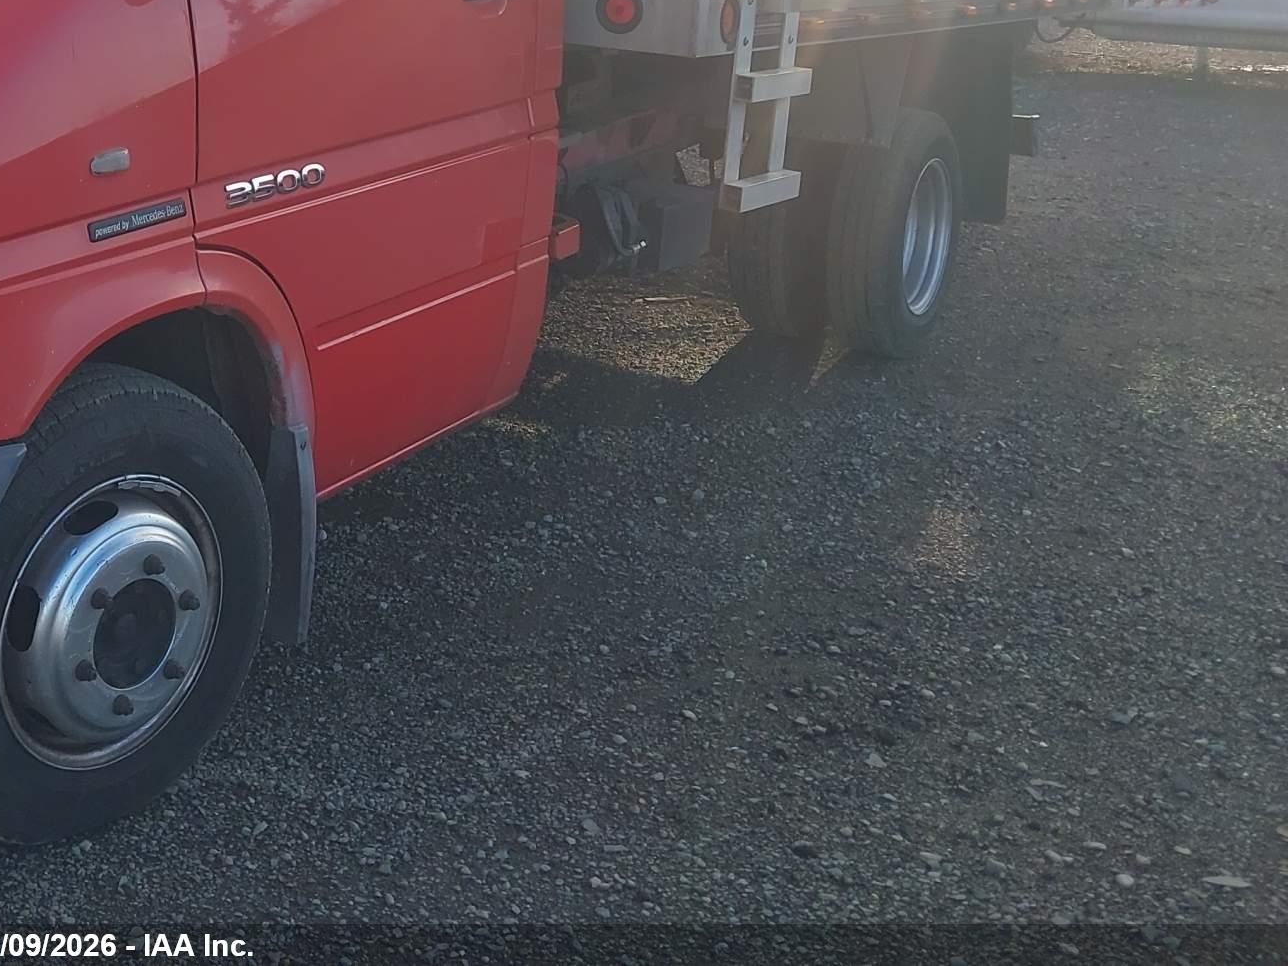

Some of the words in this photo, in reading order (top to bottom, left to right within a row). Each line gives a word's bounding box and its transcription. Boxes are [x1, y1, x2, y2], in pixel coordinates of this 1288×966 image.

[224, 163, 326, 210] 3500
[95, 221, 121, 240] powered
[122, 220, 130, 232] by
[131, 203, 185, 227] Mercedes-Benz
